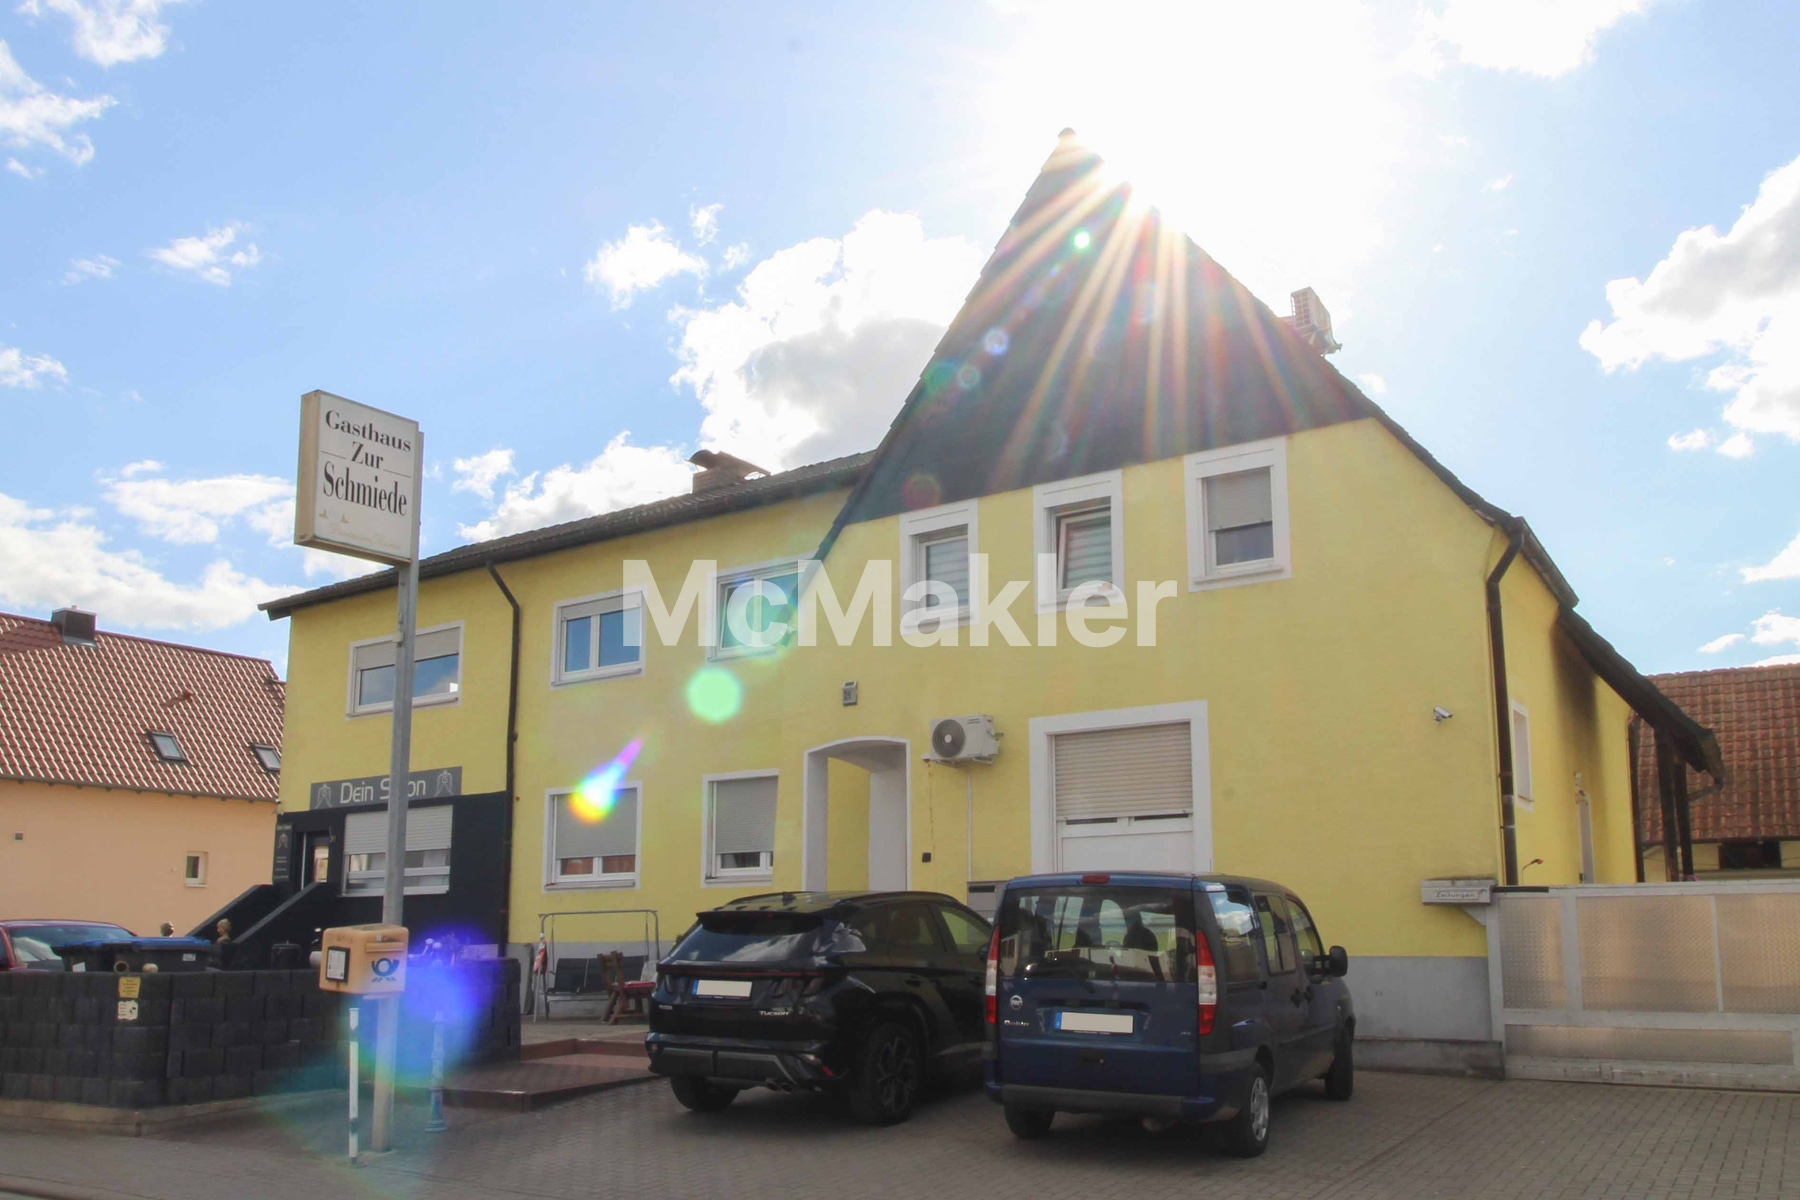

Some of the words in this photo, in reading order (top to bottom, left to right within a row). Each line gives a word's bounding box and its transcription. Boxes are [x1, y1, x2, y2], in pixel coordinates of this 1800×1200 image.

[325, 409, 411, 452] Gasthaus
[351, 441, 384, 470] Zur
[323, 460, 407, 516] Schmiede
[340, 781, 374, 804] Dein
[380, 777, 426, 800] Son
